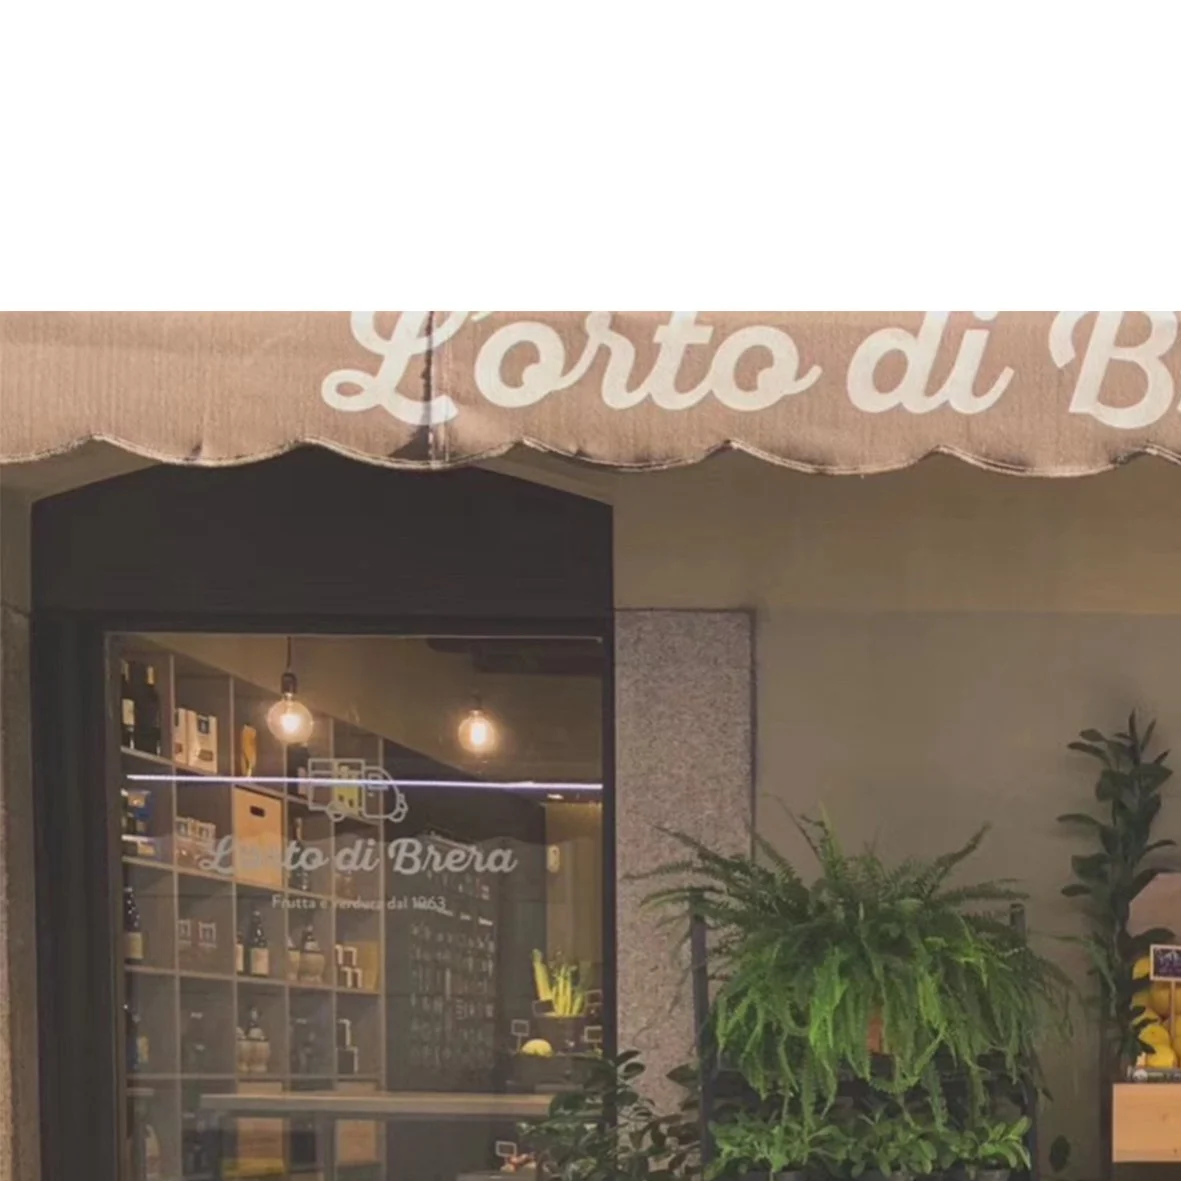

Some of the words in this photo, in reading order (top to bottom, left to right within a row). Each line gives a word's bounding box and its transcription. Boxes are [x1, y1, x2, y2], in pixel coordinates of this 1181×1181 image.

[847, 311, 1014, 414] di
[199, 834, 330, 875] Loto
[335, 838, 380, 871] di
[388, 837, 518, 875] Brera
[272, 894, 316, 909] Frutta
[387, 896, 408, 909] dal
